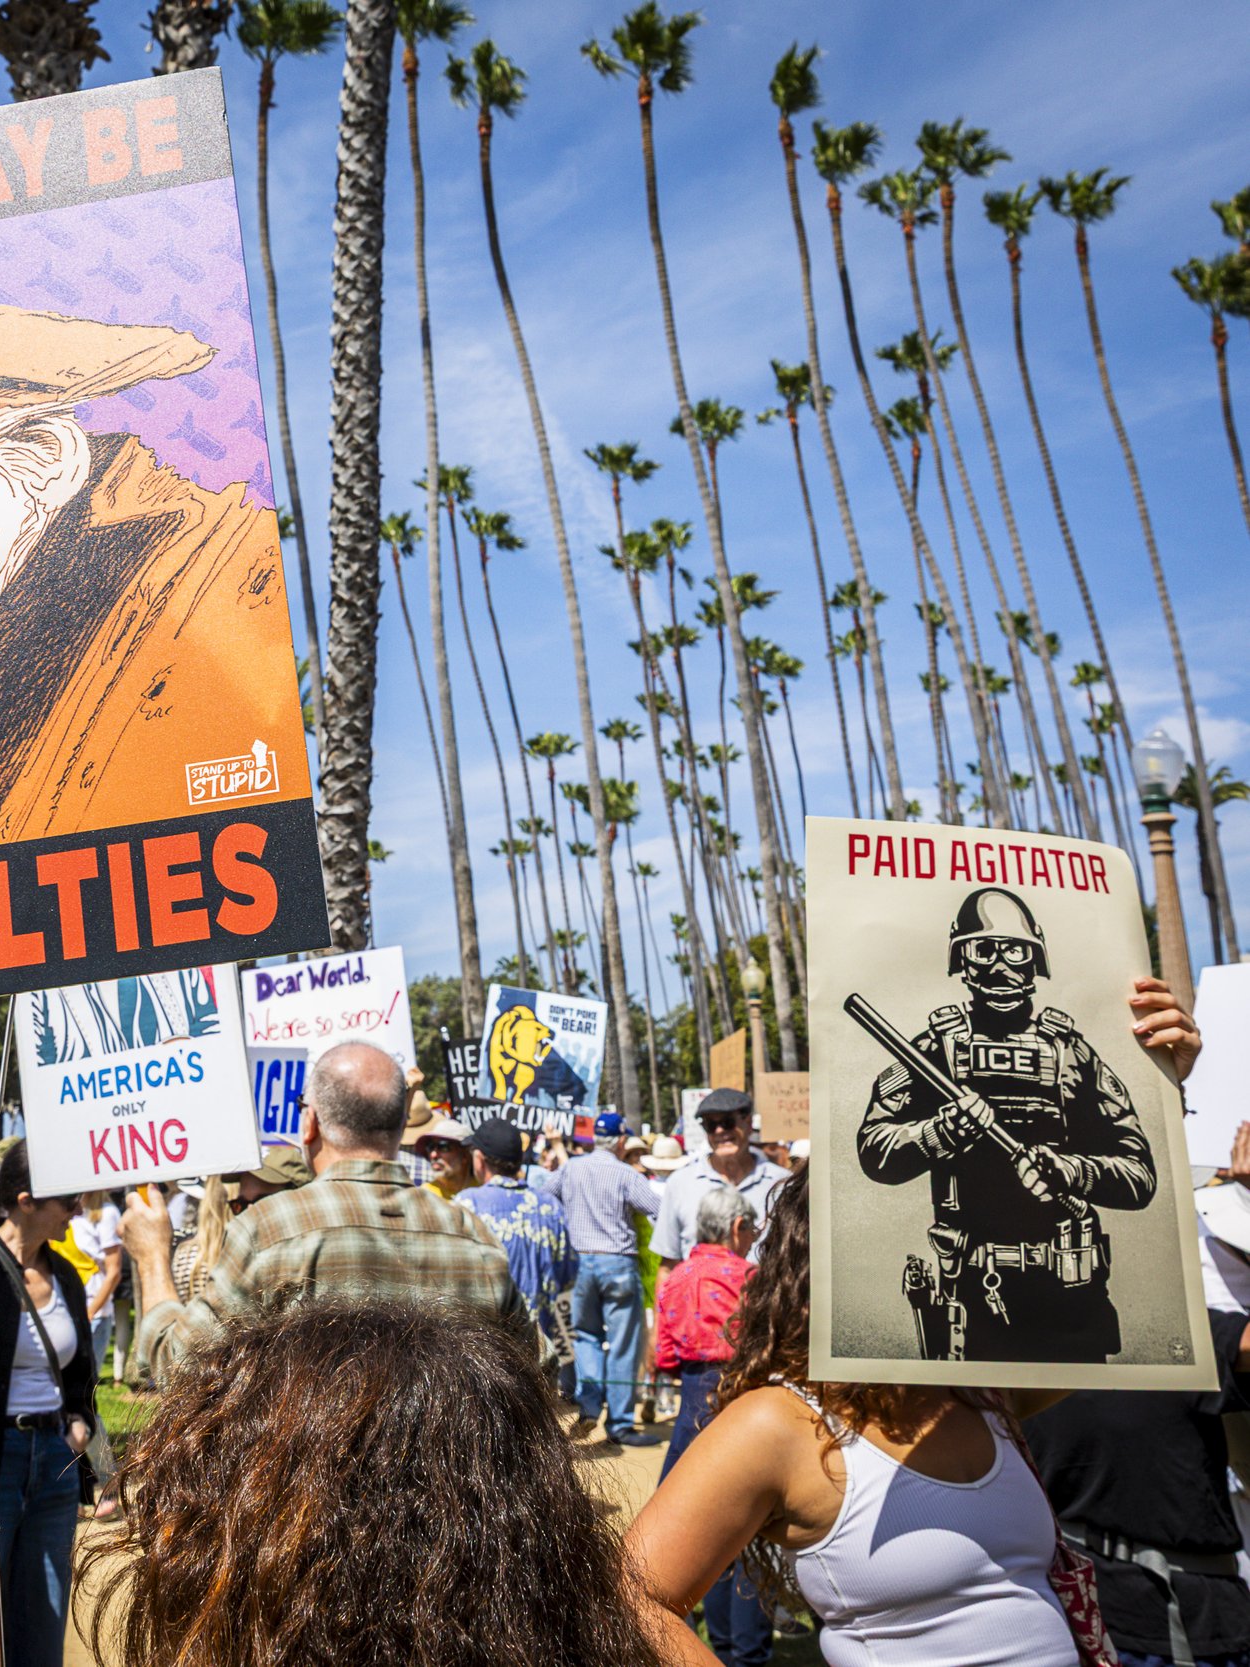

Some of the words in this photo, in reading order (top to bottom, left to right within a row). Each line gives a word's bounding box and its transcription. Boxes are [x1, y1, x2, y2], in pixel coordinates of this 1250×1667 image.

[83, 96, 184, 187] BE
[190, 764, 225, 779] STAND
[227, 762, 241, 773] UP
[242, 760, 255, 770] TO
[193, 768, 272, 800] STUPID
[848, 833, 937, 879] PAID
[950, 840, 1111, 895] AGITATOR
[255, 970, 303, 1002] Dear
[307, 956, 371, 990] World,
[248, 1008, 279, 1041] We
[281, 1017, 310, 1038] are
[562, 1018, 597, 1035] BEAR!
[448, 1045, 479, 1073] HE
[978, 1047, 1034, 1073] ICE
[60, 1049, 204, 1104] AMERICA'S
[112, 1101, 145, 1117] ONLY
[88, 1118, 189, 1175] KING
